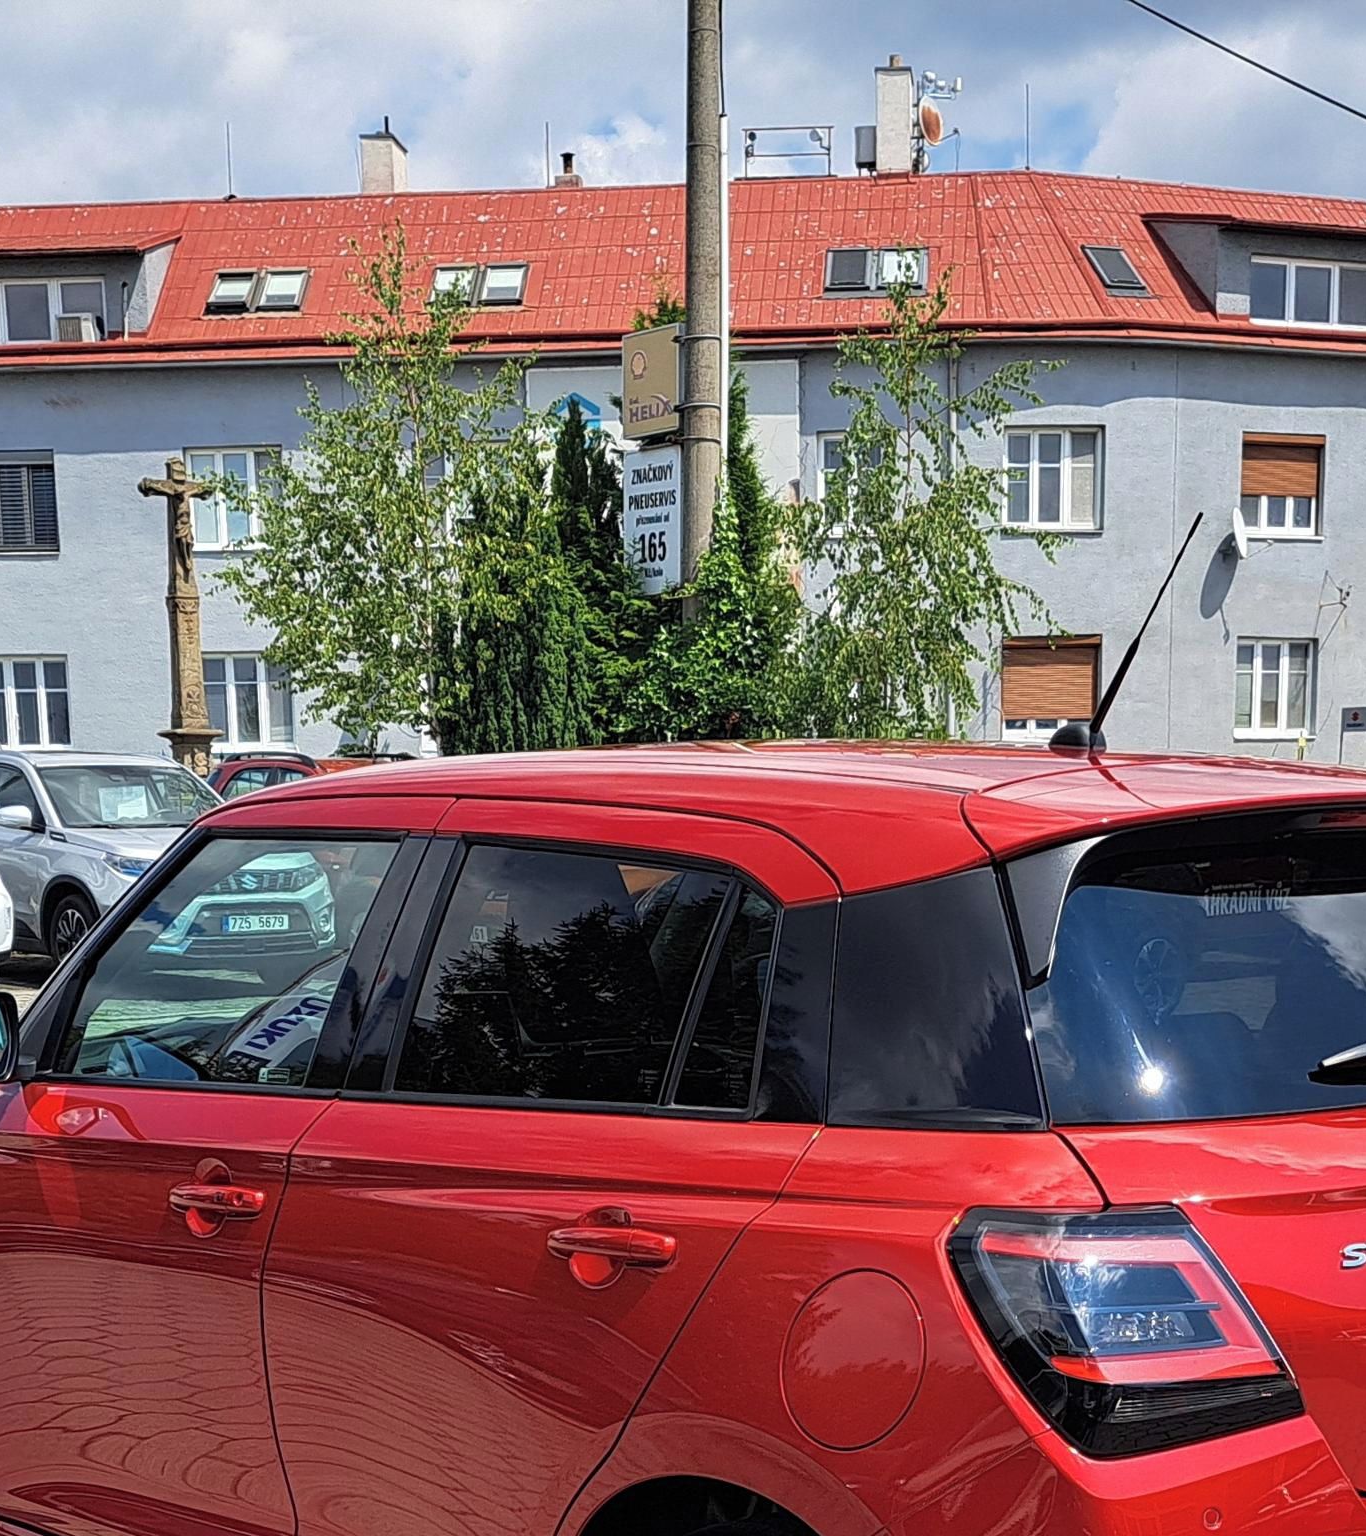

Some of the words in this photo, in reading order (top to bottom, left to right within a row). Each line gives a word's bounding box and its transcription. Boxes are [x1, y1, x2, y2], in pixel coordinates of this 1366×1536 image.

[629, 393, 674, 424] HELIX
[631, 461, 674, 485] ZNAČKOVÝ
[628, 489, 677, 511] PNEUSERVIS
[638, 531, 667, 564] 165
[258, 916, 284, 928] 5679
